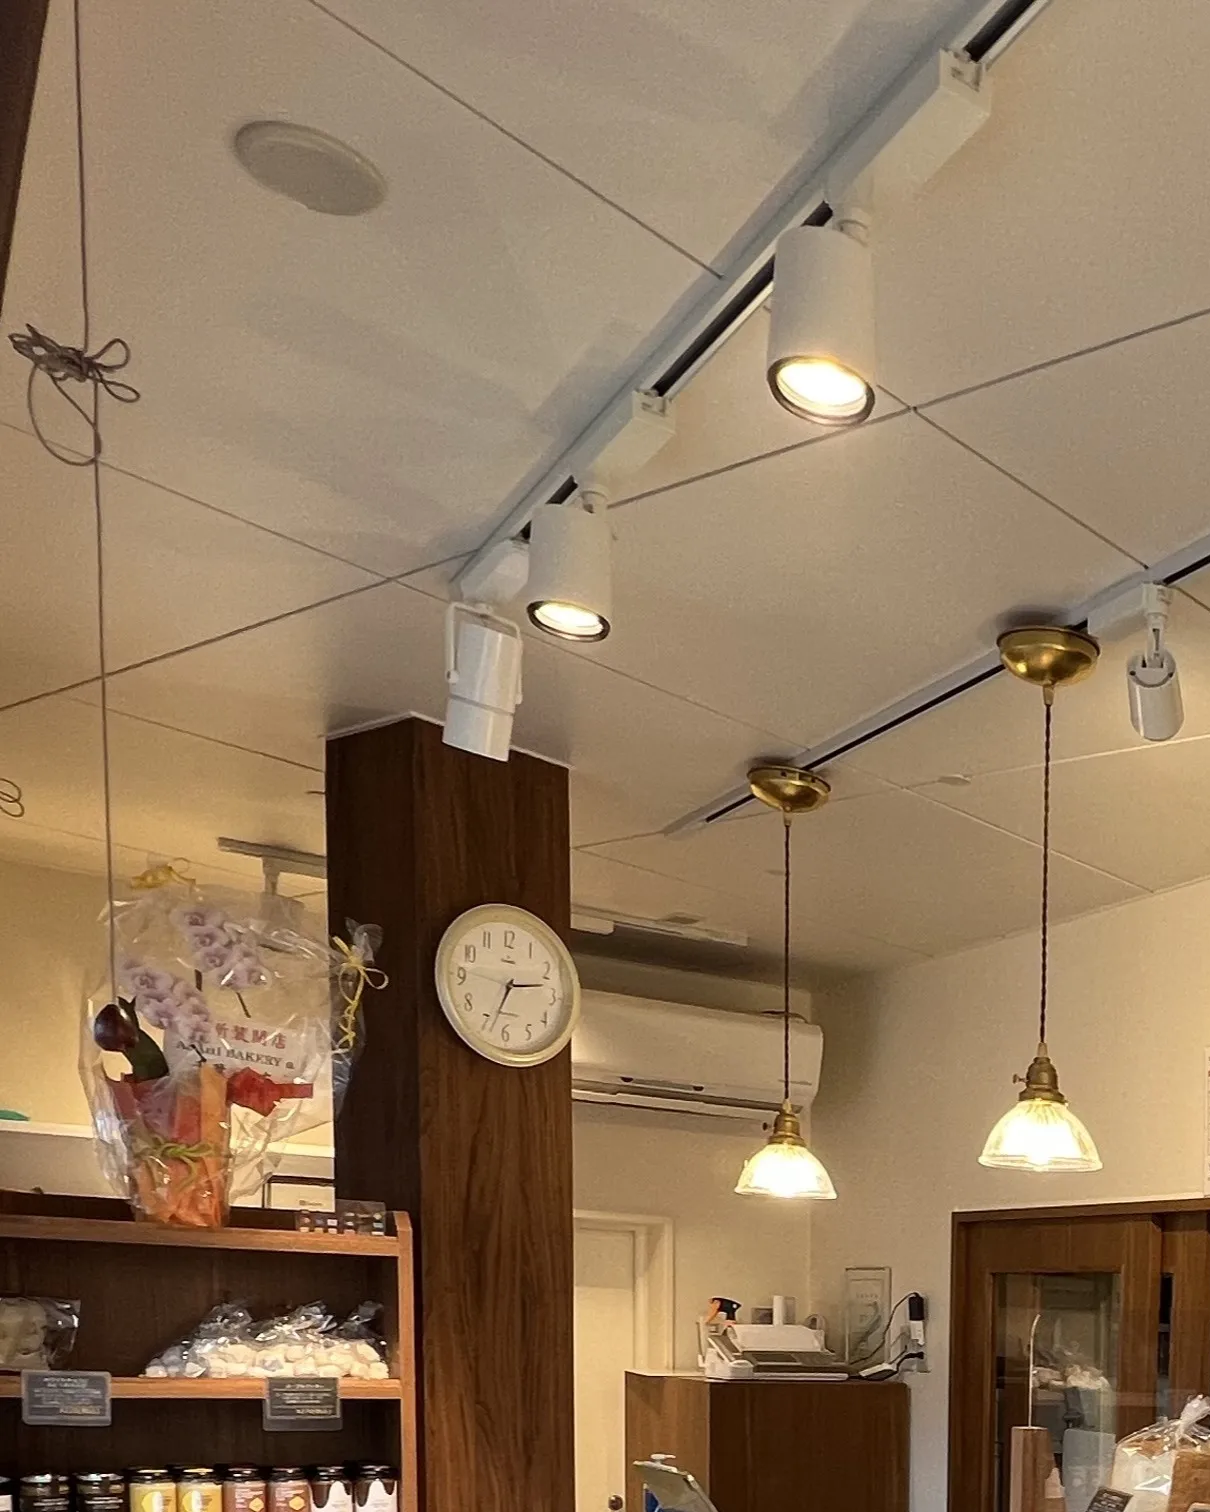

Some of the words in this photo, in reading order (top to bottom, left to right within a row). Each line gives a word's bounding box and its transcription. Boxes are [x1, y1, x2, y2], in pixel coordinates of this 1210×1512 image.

[482, 930, 492, 949] 11
[503, 930, 516, 949] 12
[464, 944, 476, 963] 10
[528, 941, 533, 959] 1
[456, 966, 467, 985] 9
[542, 961, 551, 980] 2
[463, 993, 473, 1012] 8
[549, 987, 556, 1006] 3
[481, 1013, 490, 1031] 7
[540, 1010, 548, 1028] 4
[501, 1023, 510, 1042] 6
[524, 1023, 532, 1041] 5
[225, 1048, 284, 1067] BAKERY
